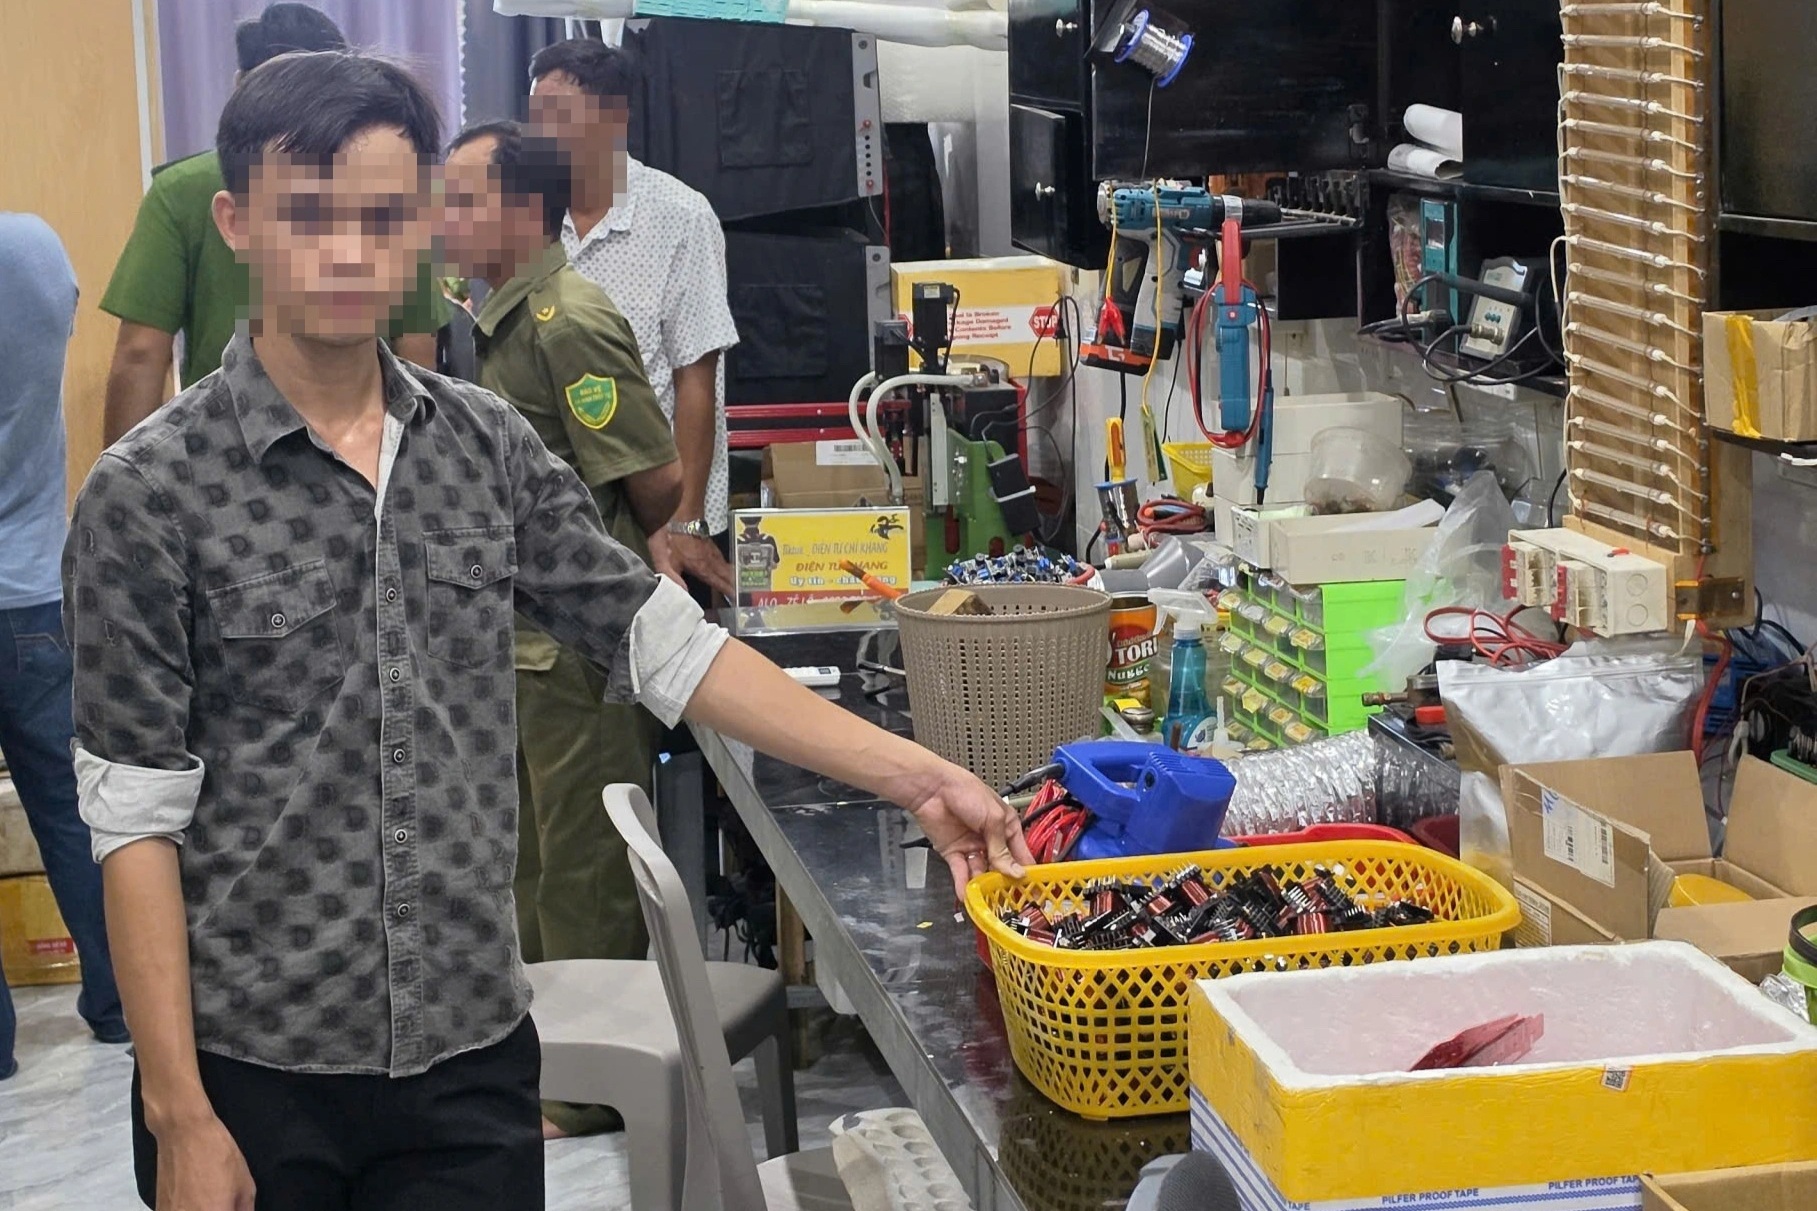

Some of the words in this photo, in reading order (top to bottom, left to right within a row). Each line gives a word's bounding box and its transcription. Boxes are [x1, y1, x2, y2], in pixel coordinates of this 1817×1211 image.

[1033, 314, 1058, 329] STOP
[1549, 1179, 1583, 1190] PILFER
[1585, 1176, 1619, 1187] PROOF
[1621, 1174, 1640, 1184] TAP
[1382, 1193, 1417, 1204] PILFER
[1419, 1190, 1453, 1202] PROOF
[1454, 1188, 1479, 1198] TAPE
[1287, 1202, 1311, 1211] TAPE
